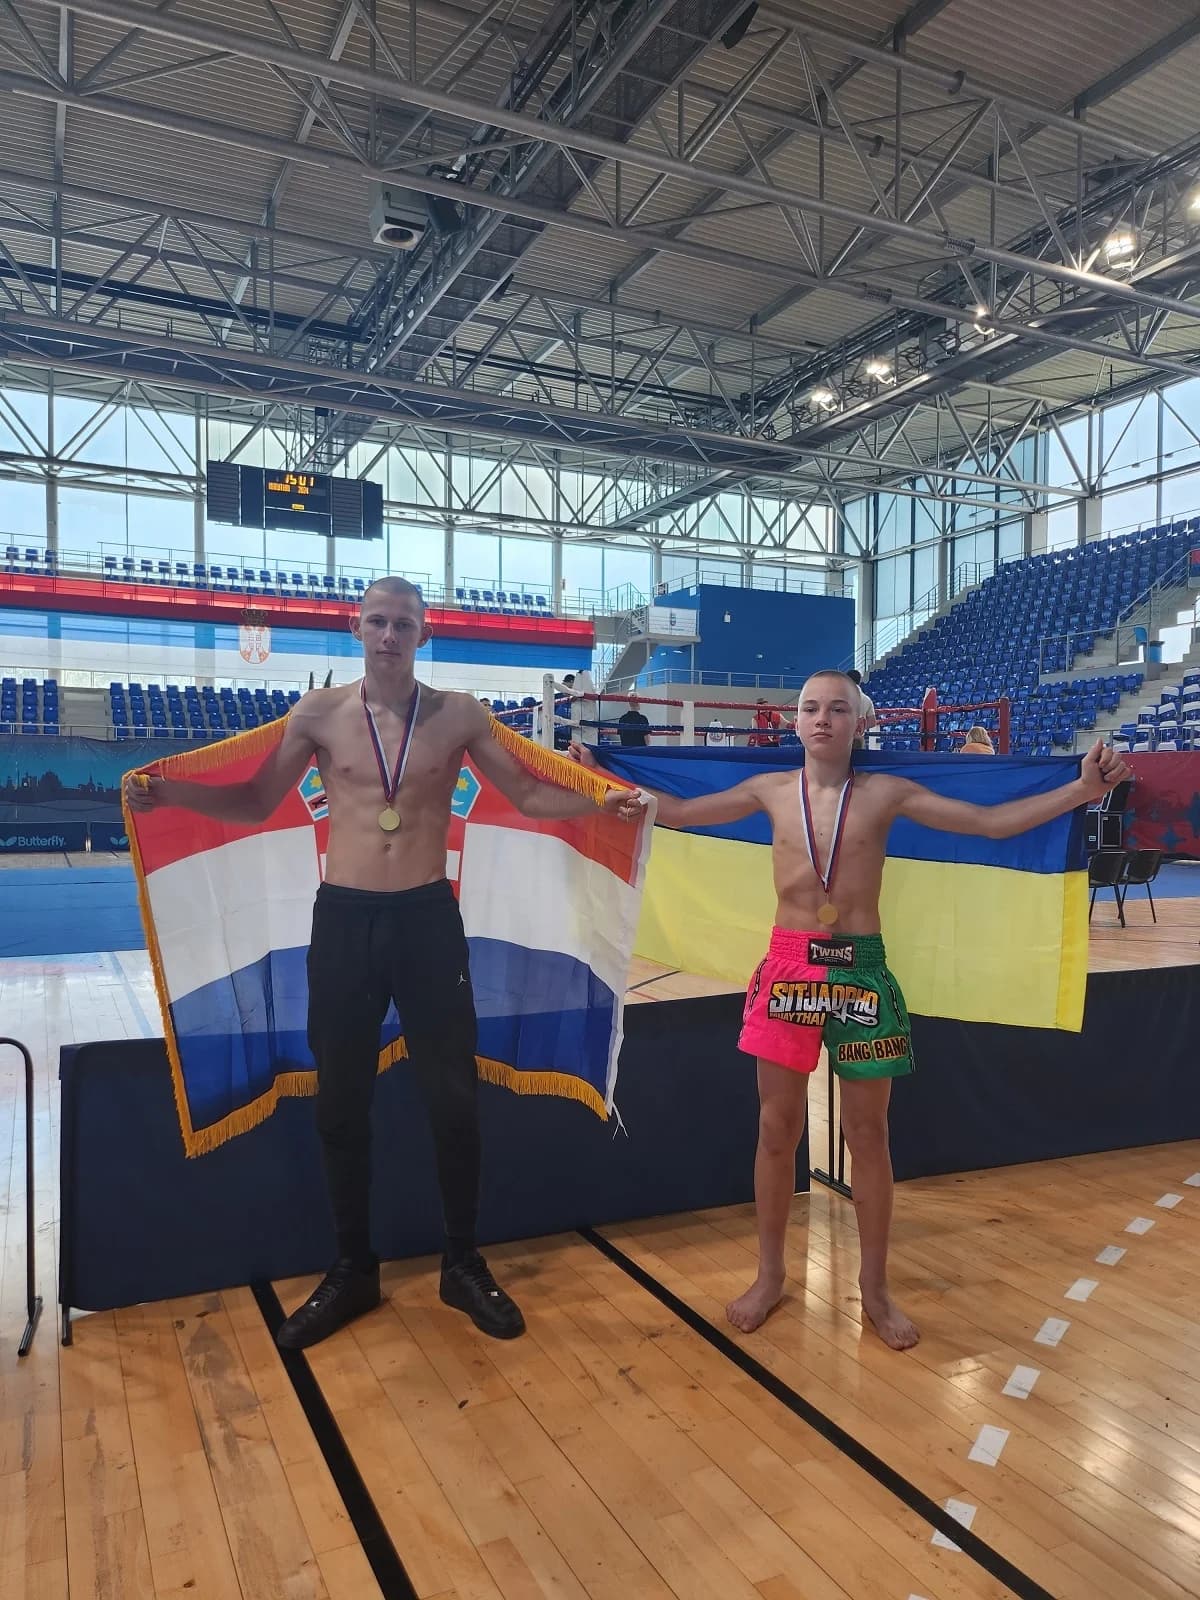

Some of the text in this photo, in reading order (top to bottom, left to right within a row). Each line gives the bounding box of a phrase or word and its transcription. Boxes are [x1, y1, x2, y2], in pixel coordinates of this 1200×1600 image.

[811, 943, 853, 961] TWINS
[795, 1012, 826, 1026] THAI
[838, 1038, 908, 1062] BANG BANG
